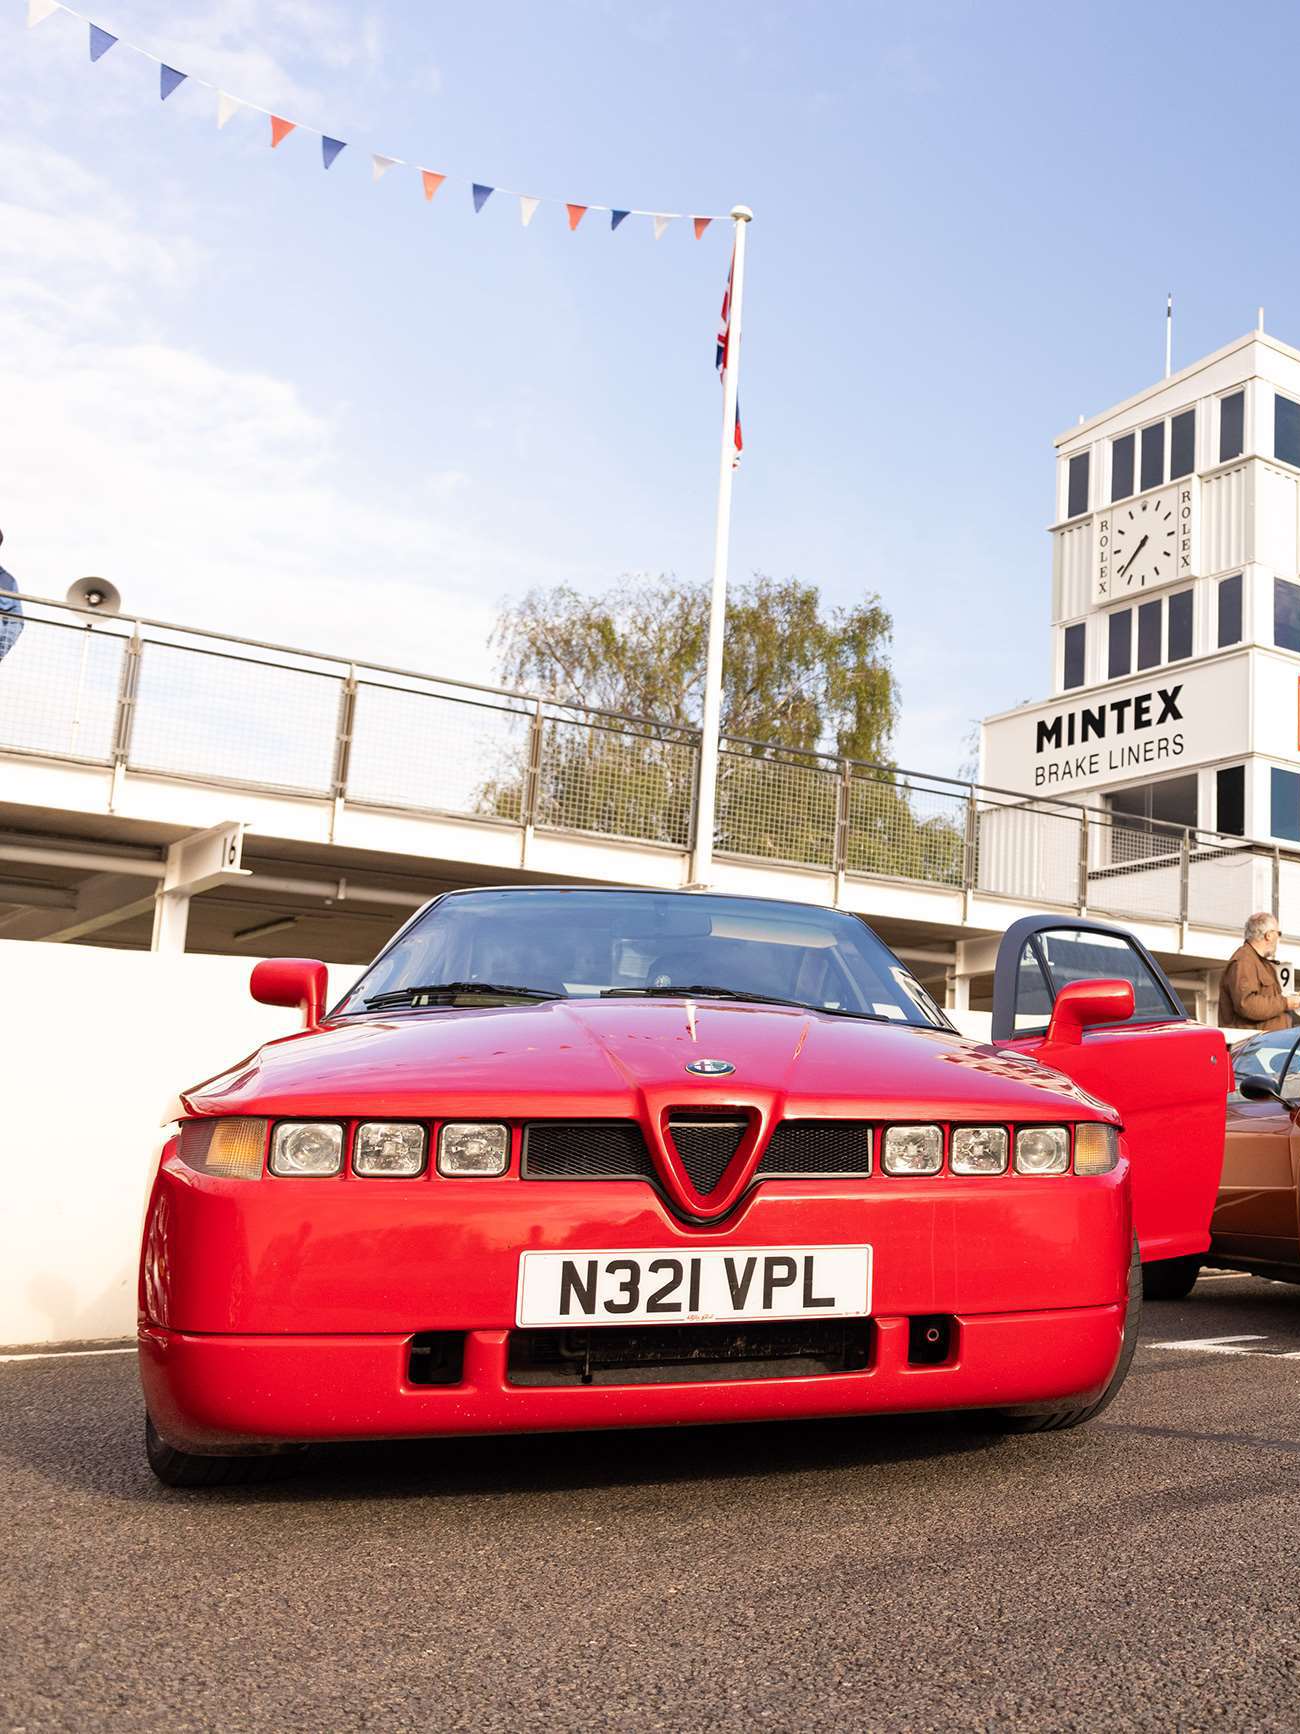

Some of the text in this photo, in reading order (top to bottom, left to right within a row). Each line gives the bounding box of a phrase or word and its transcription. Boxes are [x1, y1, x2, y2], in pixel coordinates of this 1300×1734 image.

[1098, 519, 1109, 594] ROLEX
[1181, 490, 1191, 568] ROLEX
[1035, 683, 1184, 754] MINTEX
[1035, 733, 1185, 787] BRAKE LINERS
[221, 834, 237, 868] 16
[559, 1256, 836, 1316] N321 VPL
